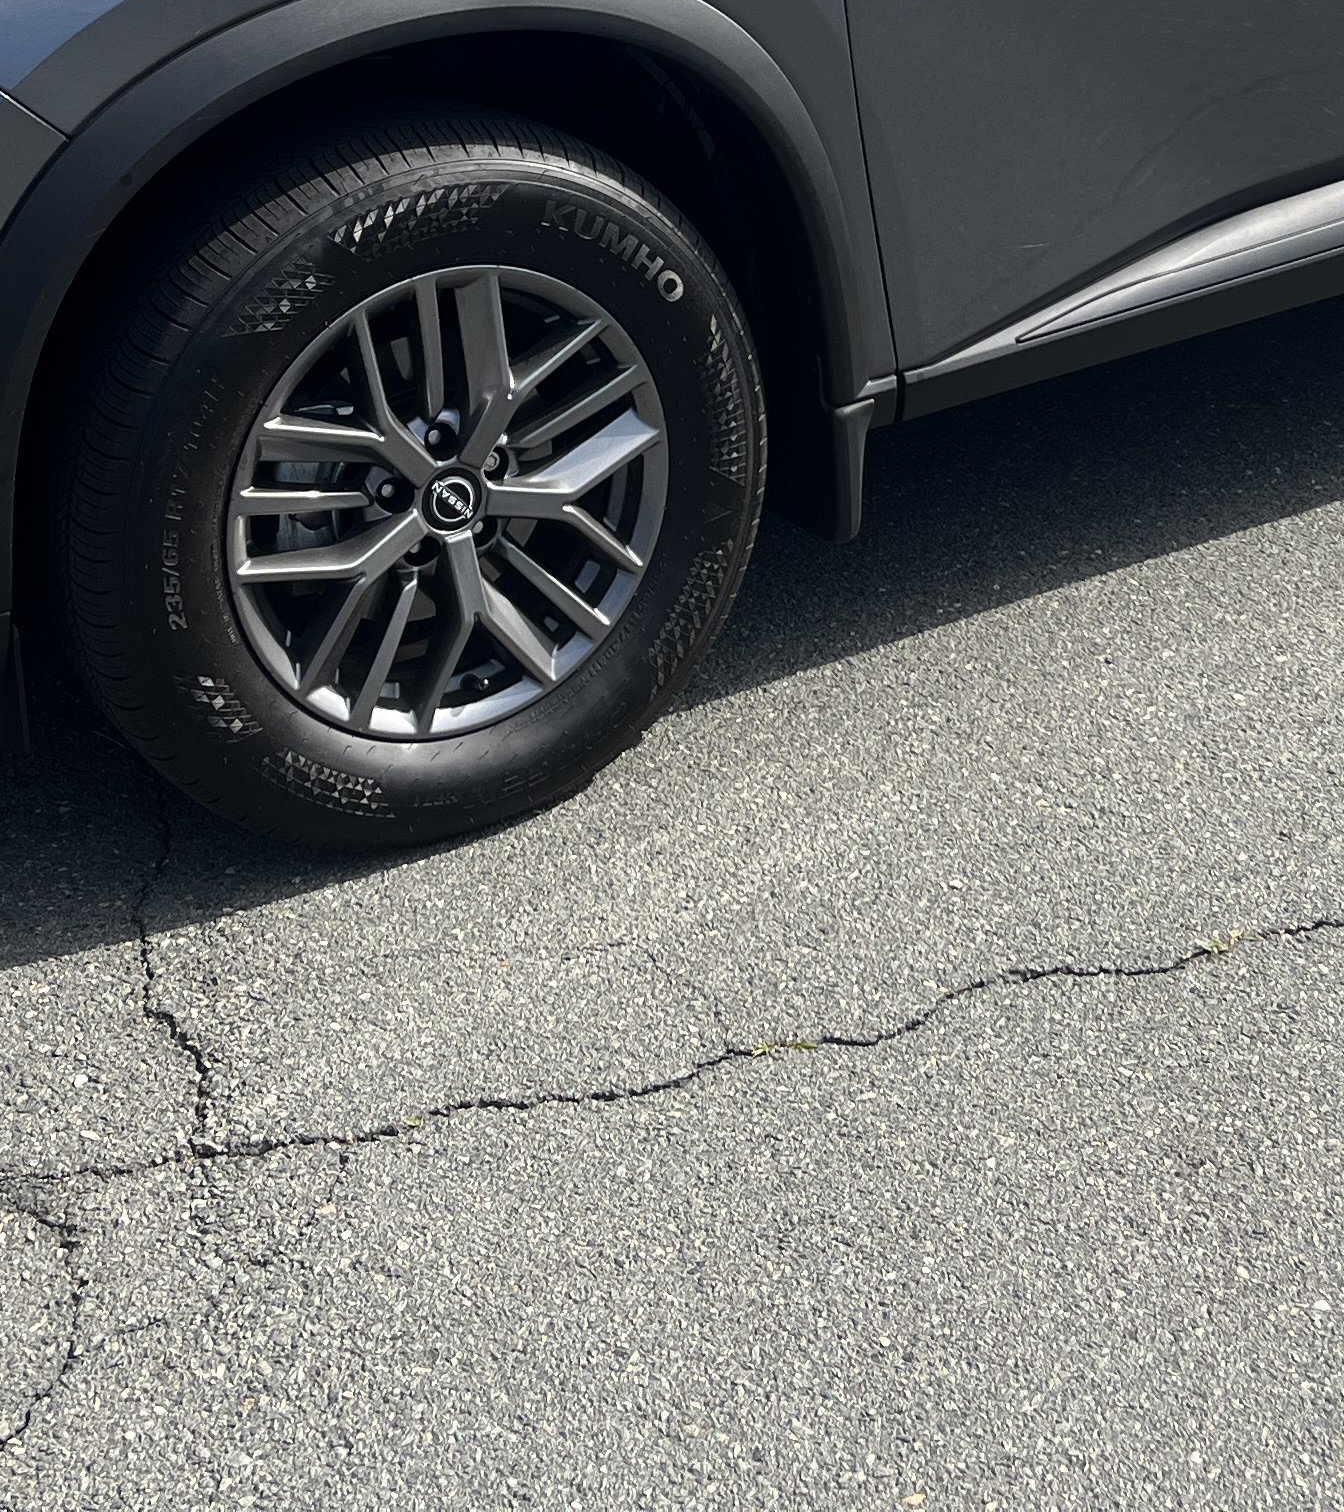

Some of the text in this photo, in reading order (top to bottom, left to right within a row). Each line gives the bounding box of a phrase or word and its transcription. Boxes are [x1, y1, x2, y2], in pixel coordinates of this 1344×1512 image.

[540, 199, 685, 304] KUMHO
[431, 479, 474, 519] NISSAN
[160, 528, 190, 632] 235/65
